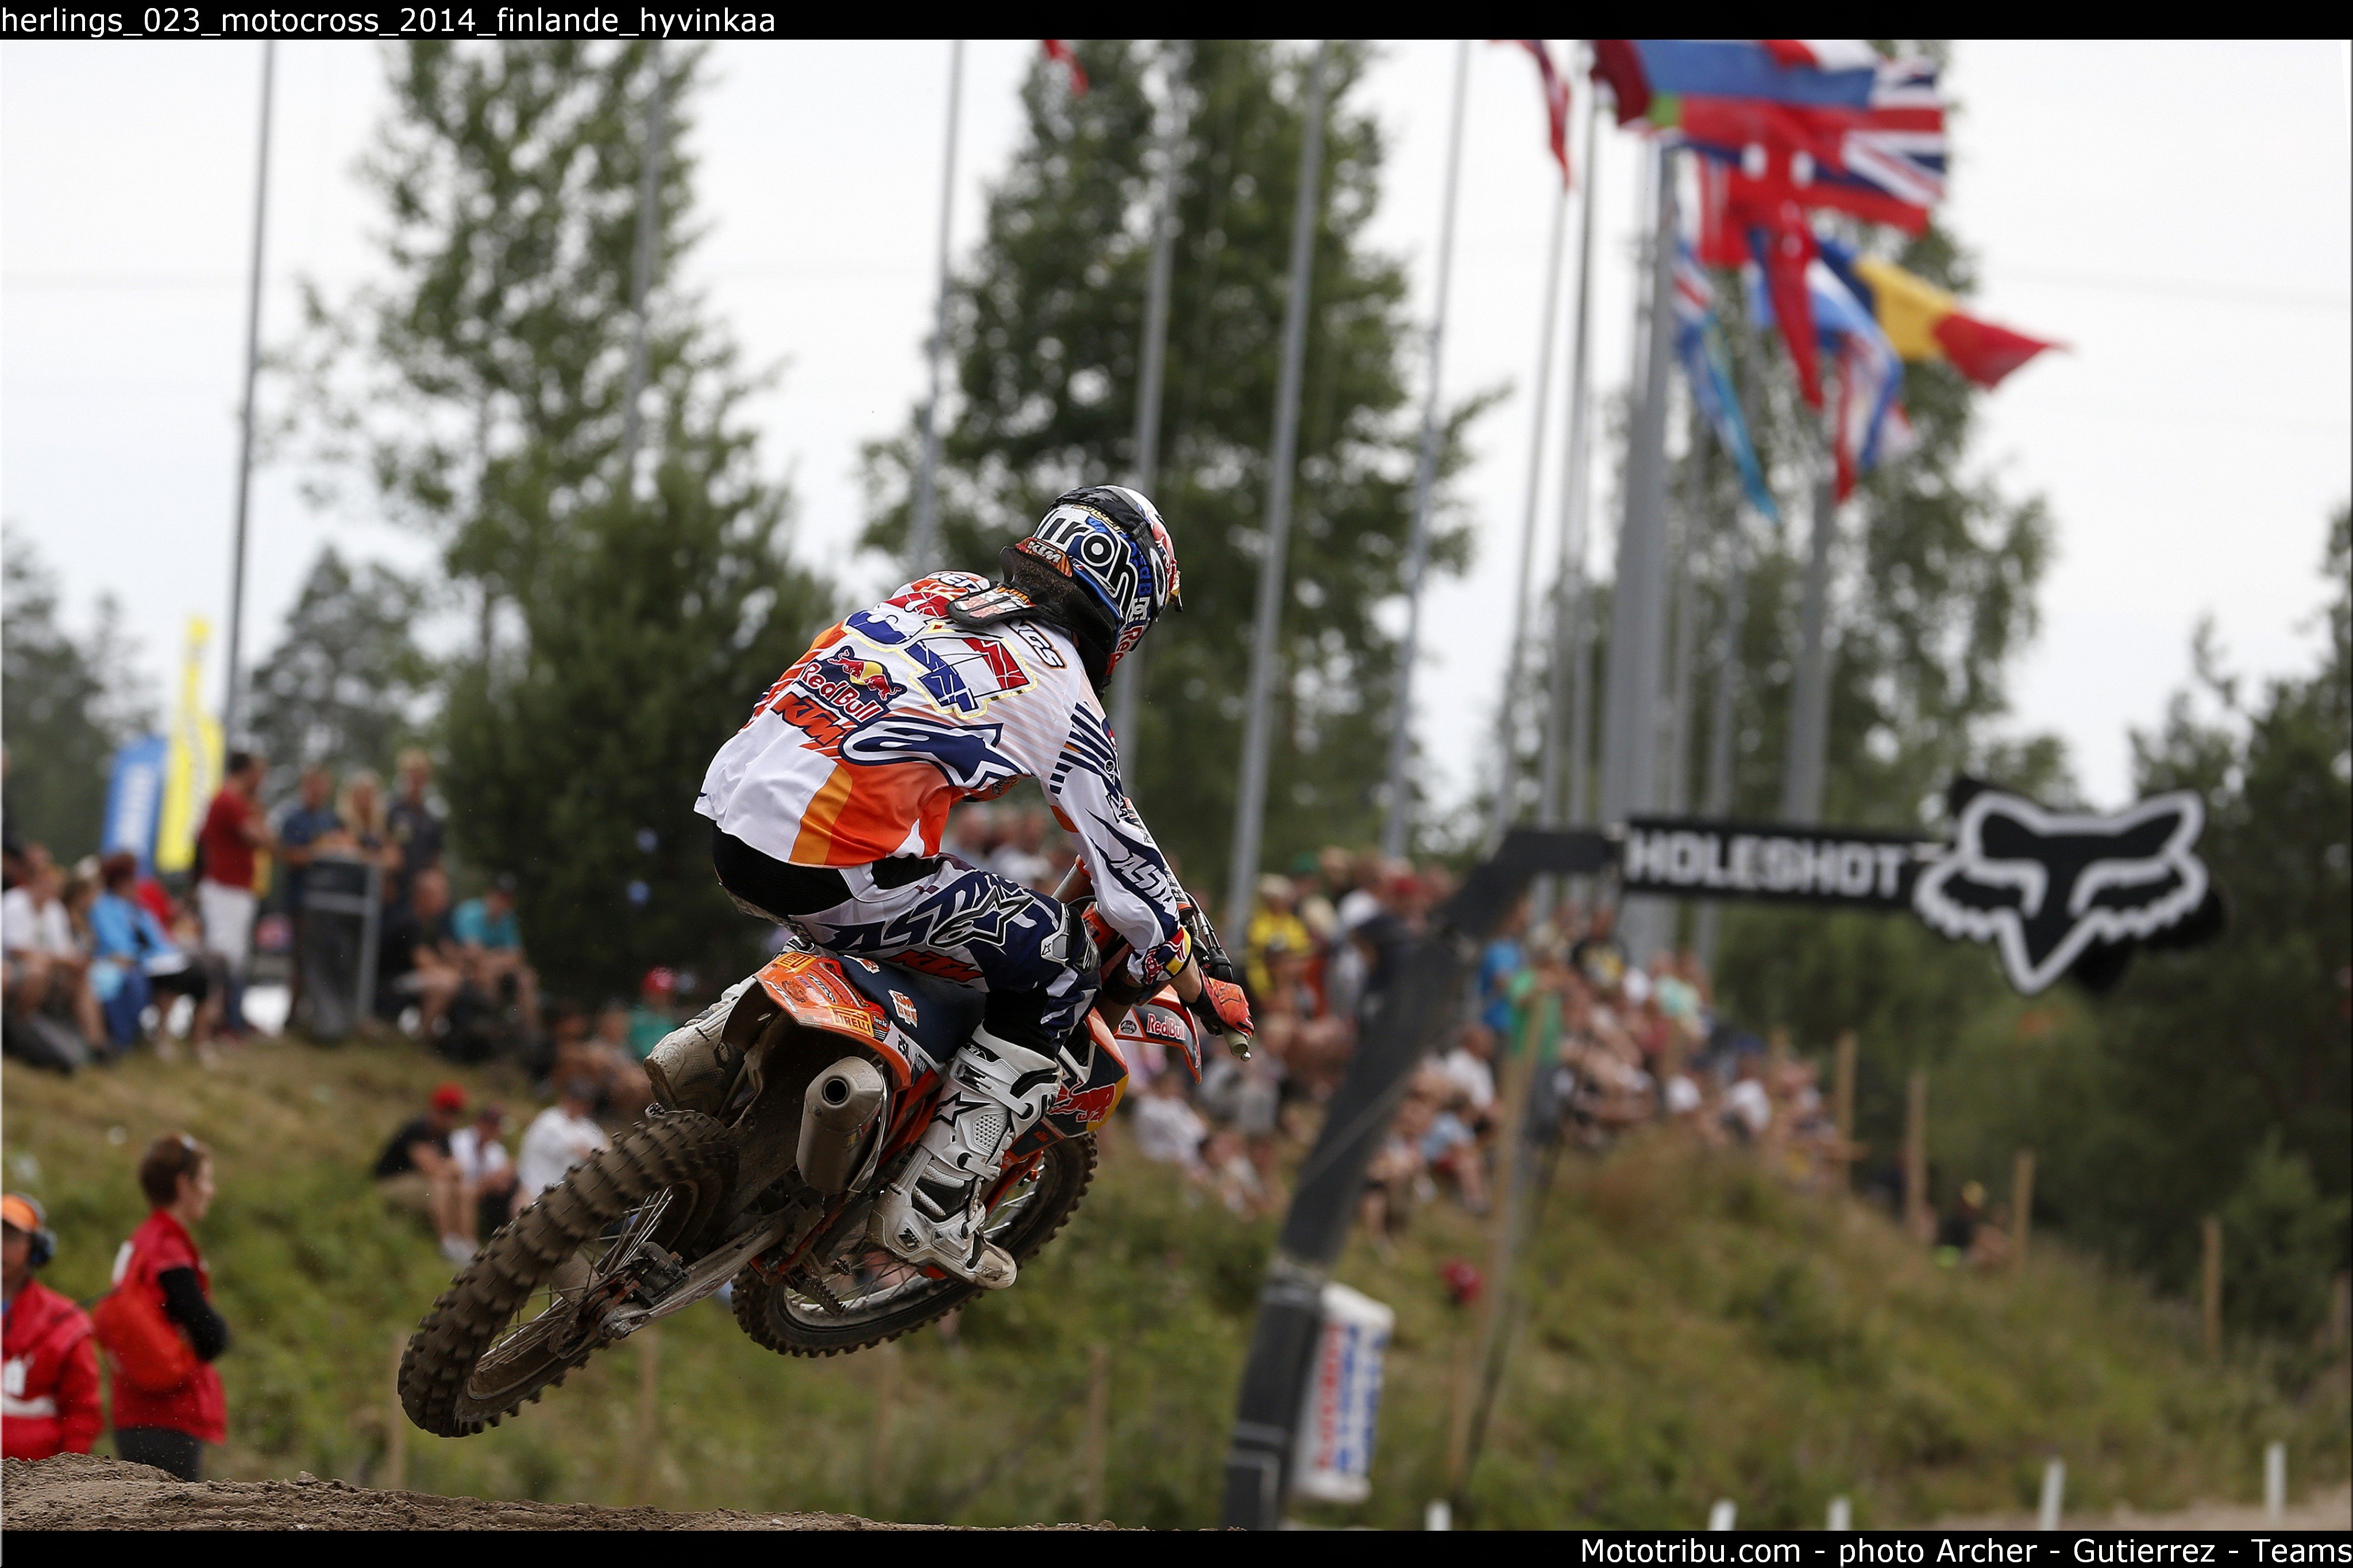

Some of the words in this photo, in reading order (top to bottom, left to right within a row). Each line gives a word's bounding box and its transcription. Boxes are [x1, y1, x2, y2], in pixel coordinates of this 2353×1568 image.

[770, 692, 846, 746] KTM
[1625, 832, 1905, 898] HOLESHOT
[832, 1007, 871, 1033] PIRELLI
